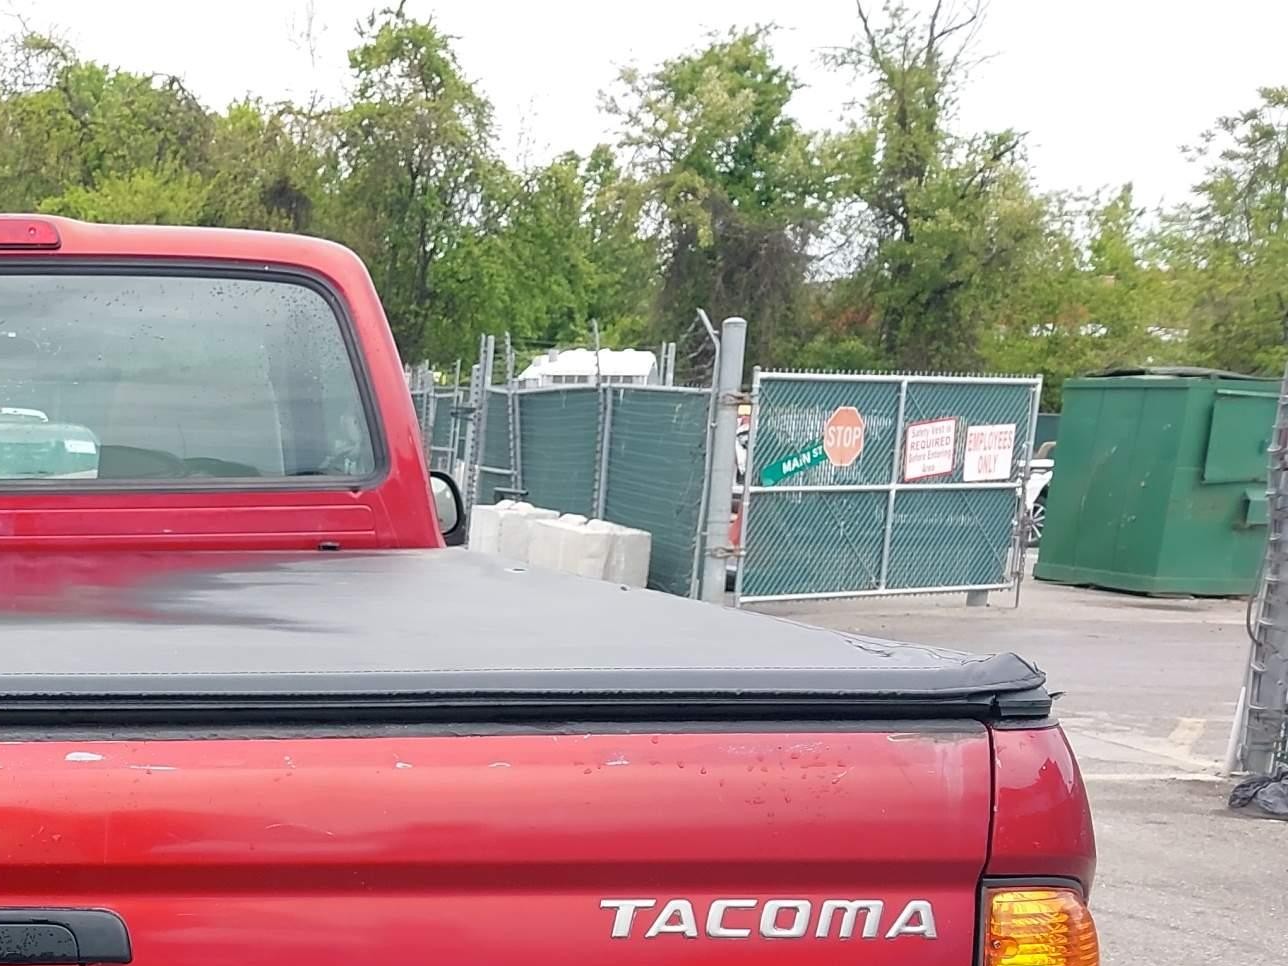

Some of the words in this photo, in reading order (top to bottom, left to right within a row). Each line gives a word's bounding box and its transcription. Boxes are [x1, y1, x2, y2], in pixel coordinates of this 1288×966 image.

[827, 426, 861, 448] STOP
[910, 436, 951, 451] REQUIRED
[967, 430, 1013, 452] EMPLOYEES
[782, 451, 811, 475] MAIN
[812, 445, 823, 458] ST
[977, 454, 998, 474] ONLY
[600, 899, 938, 939] TACOMA
